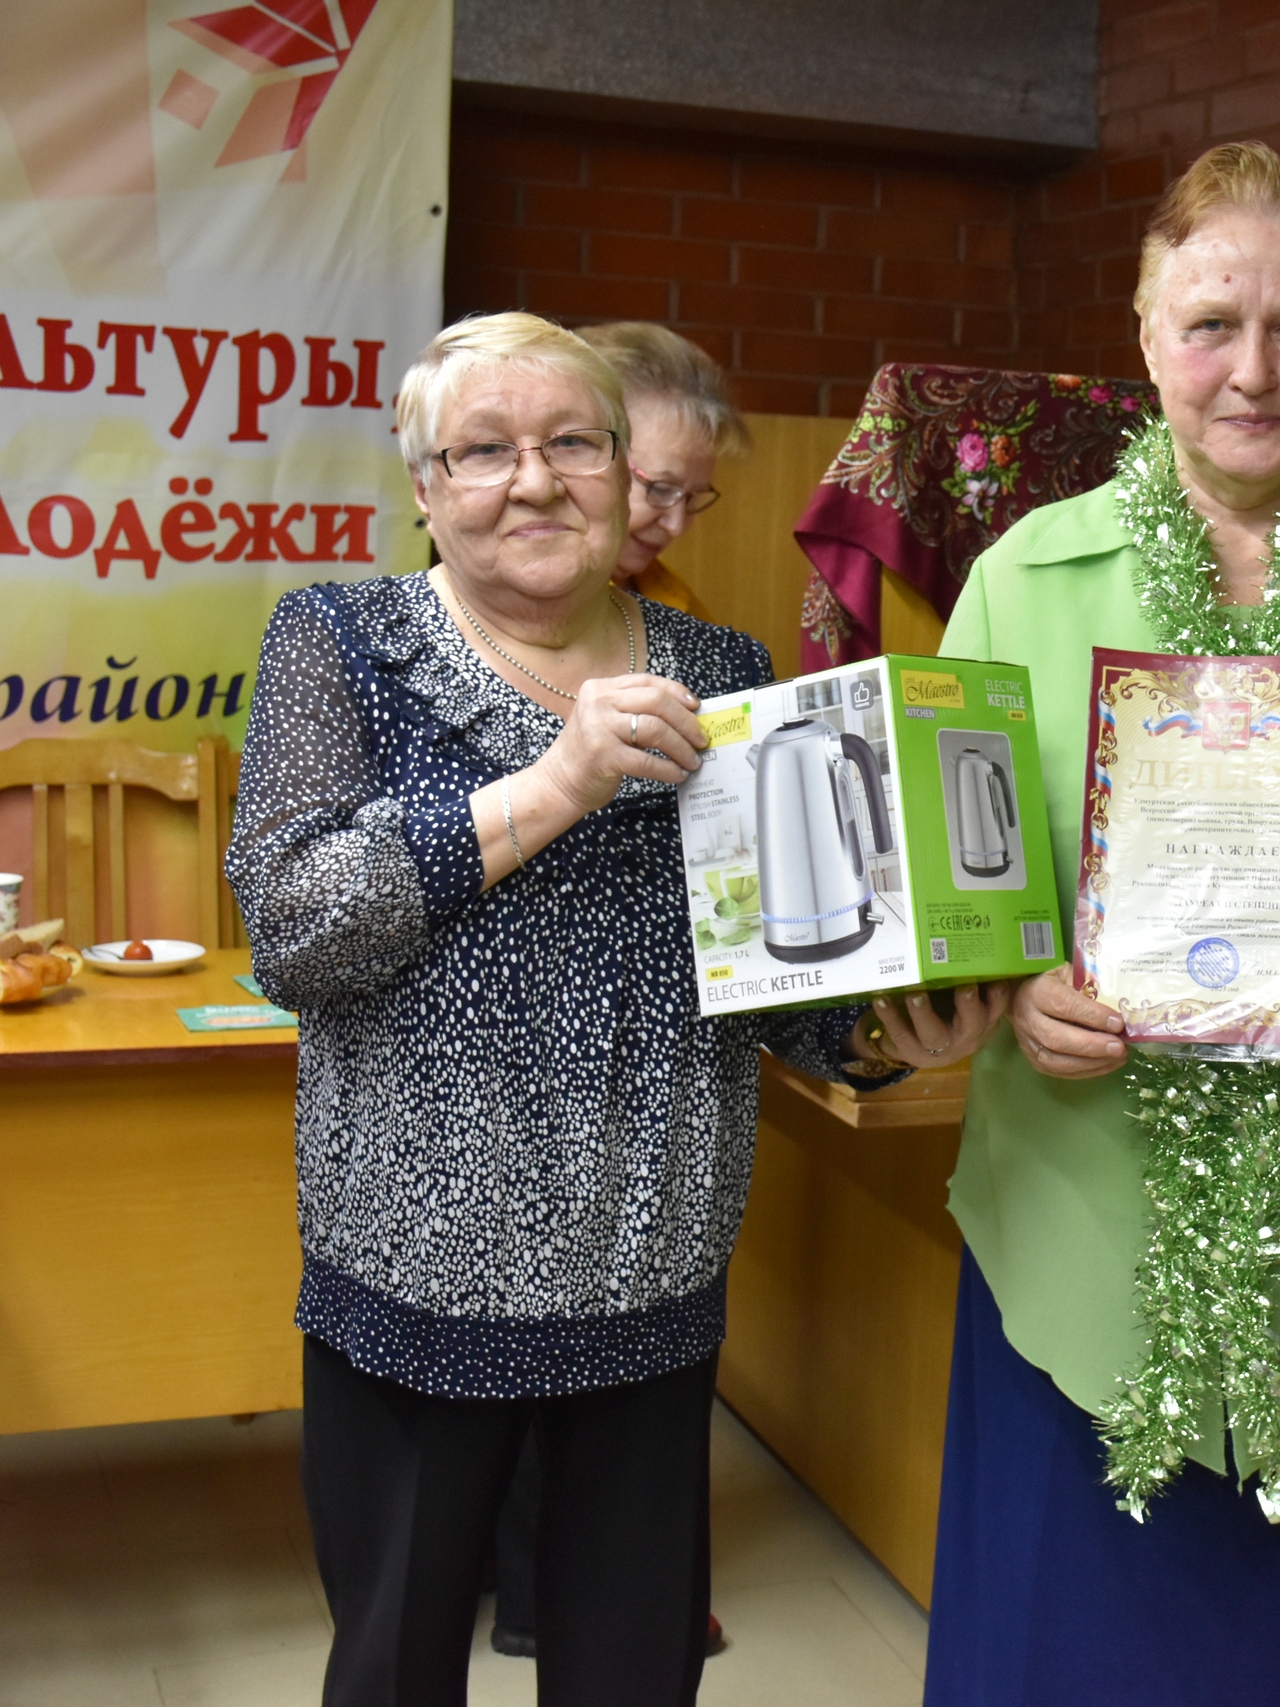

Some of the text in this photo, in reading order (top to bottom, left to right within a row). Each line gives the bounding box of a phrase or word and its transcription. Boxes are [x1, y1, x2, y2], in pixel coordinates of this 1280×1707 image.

[906, 680, 958, 701] Maestro
[985, 679, 1023, 694] ELECTRIC
[987, 693, 1026, 709] KETTLE
[905, 708, 935, 719] KITCHEN
[689, 788, 724, 800] PROTECTION
[690, 795, 740, 811] STYLISH STAINLESS
[691, 810, 722, 821] STEEL BODY
[704, 952, 734, 964] CAPACITY:
[735, 951, 744, 959] 1,7
[880, 963, 905, 974] 2200 W
[707, 970, 824, 1002] ELECTRIC KETTLE
